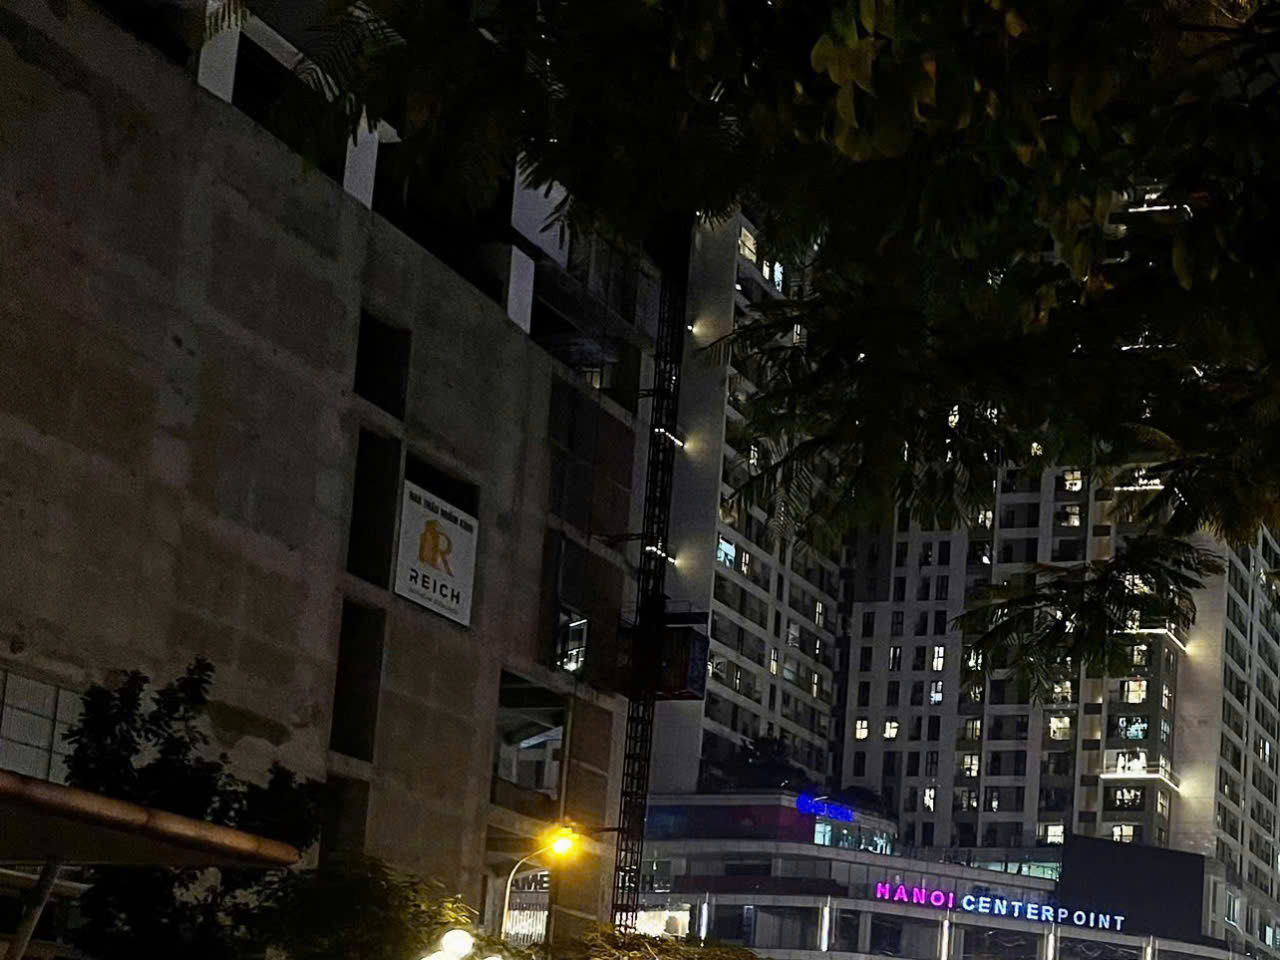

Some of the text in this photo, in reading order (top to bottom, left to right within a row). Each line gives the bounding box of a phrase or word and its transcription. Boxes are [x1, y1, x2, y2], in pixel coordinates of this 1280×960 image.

[409, 568, 461, 604] REICH
[876, 881, 1126, 932] HANOI CENTERPOINT
